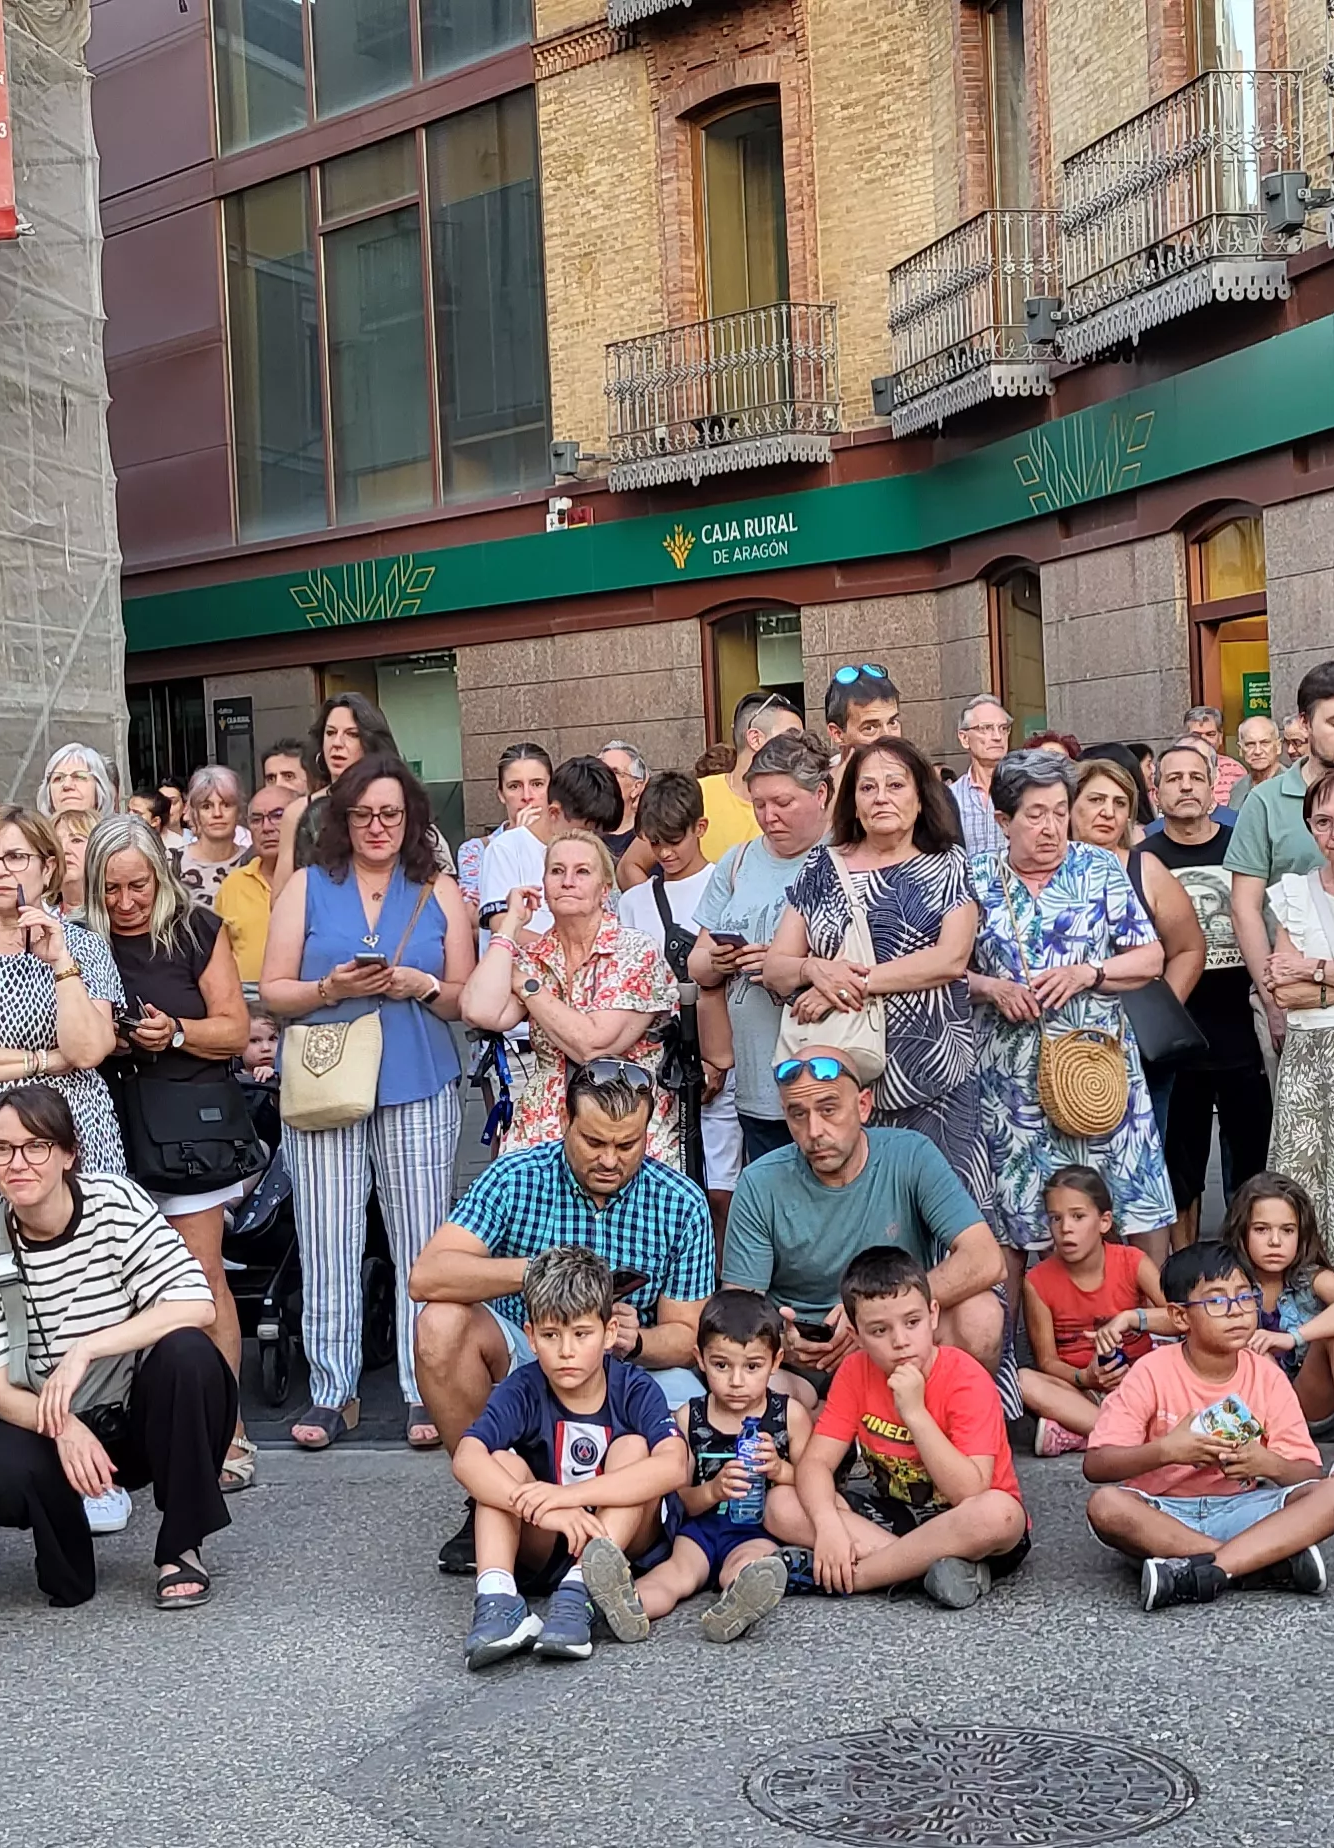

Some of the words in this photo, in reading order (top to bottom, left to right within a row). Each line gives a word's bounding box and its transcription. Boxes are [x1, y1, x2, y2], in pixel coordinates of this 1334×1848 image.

[701, 521, 741, 544] CAJA
[744, 512, 798, 539] RURAL
[713, 548, 730, 565] DE
[732, 538, 789, 563] ARAGÓN
